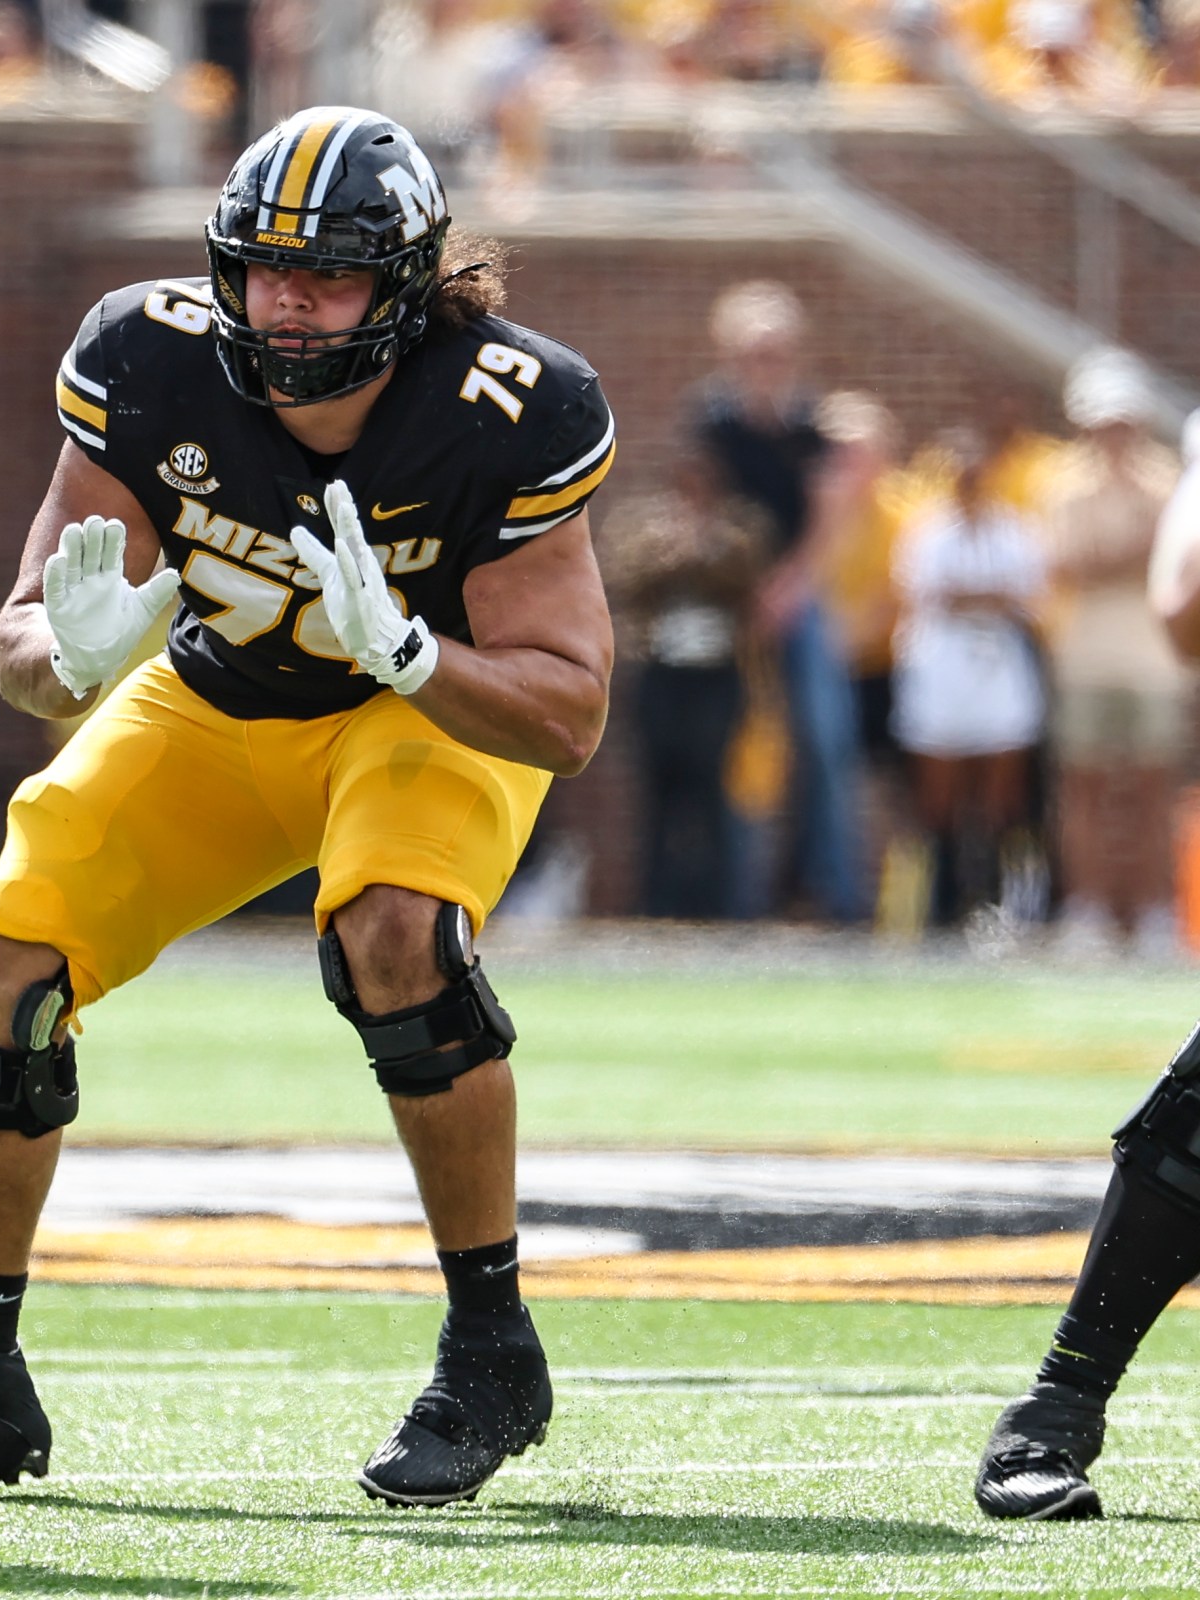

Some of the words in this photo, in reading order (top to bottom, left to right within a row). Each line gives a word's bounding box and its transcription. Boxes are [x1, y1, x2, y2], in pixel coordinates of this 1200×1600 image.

[256, 232, 308, 249] MIZZOU
[459, 342, 542, 424] 79
[174, 445, 205, 477] SEC
[163, 471, 210, 493] GRADUATE
